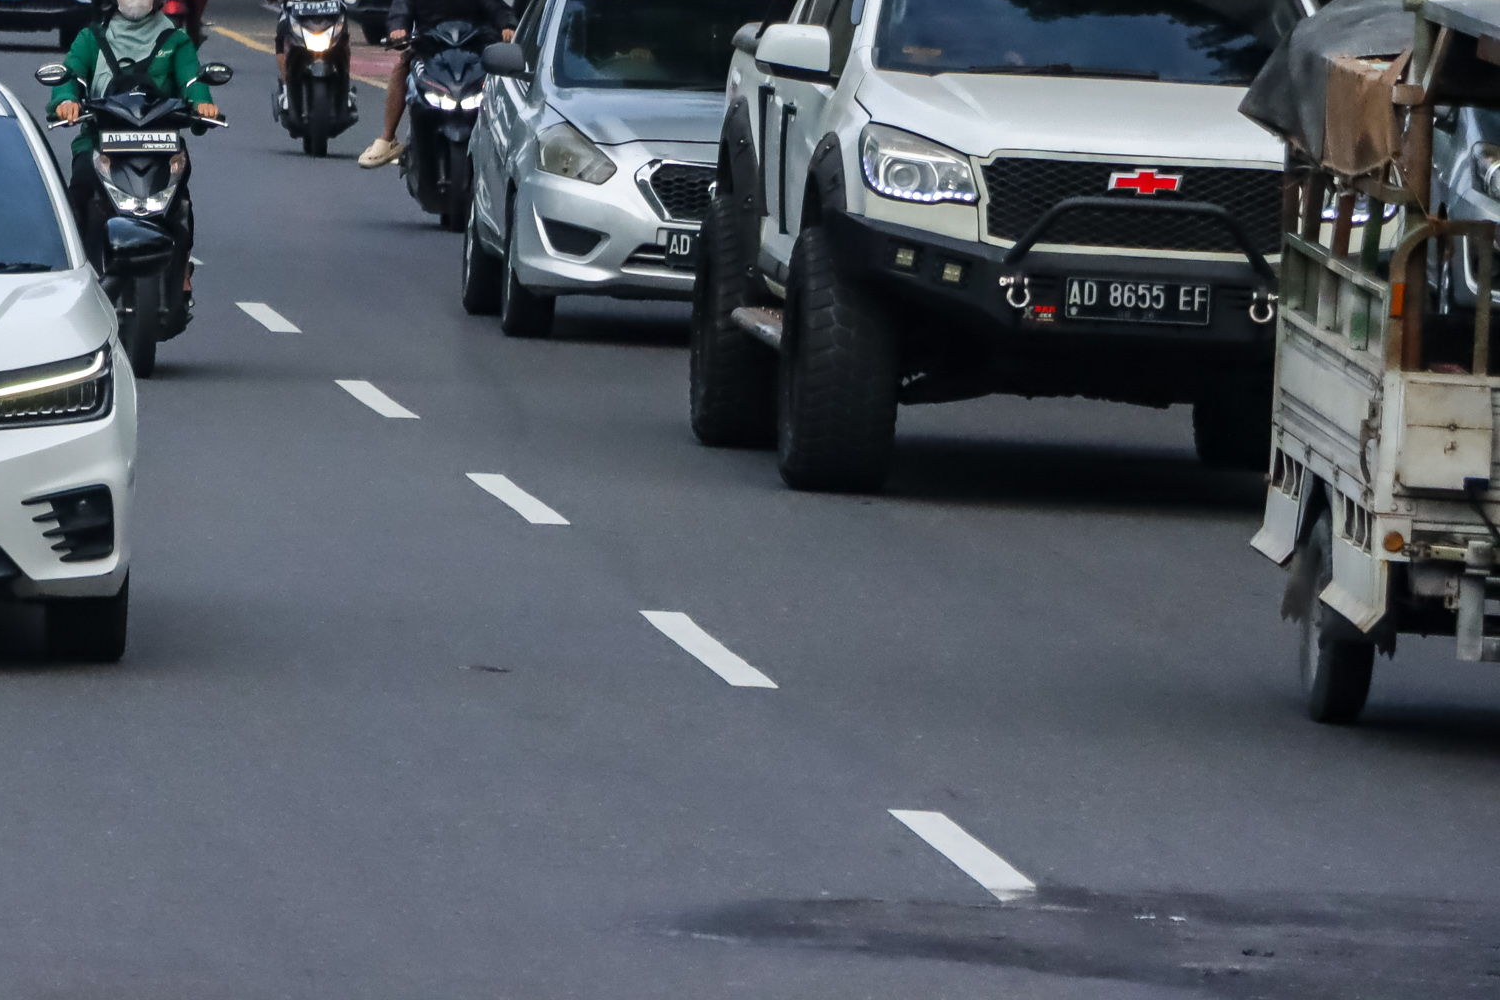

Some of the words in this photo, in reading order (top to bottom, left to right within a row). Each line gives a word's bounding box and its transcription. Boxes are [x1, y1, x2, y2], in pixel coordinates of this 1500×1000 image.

[669, 234, 690, 255] AD
[1069, 280, 1097, 306] AD
[1109, 283, 1165, 309] 8655
[1178, 286, 1207, 311] EF
